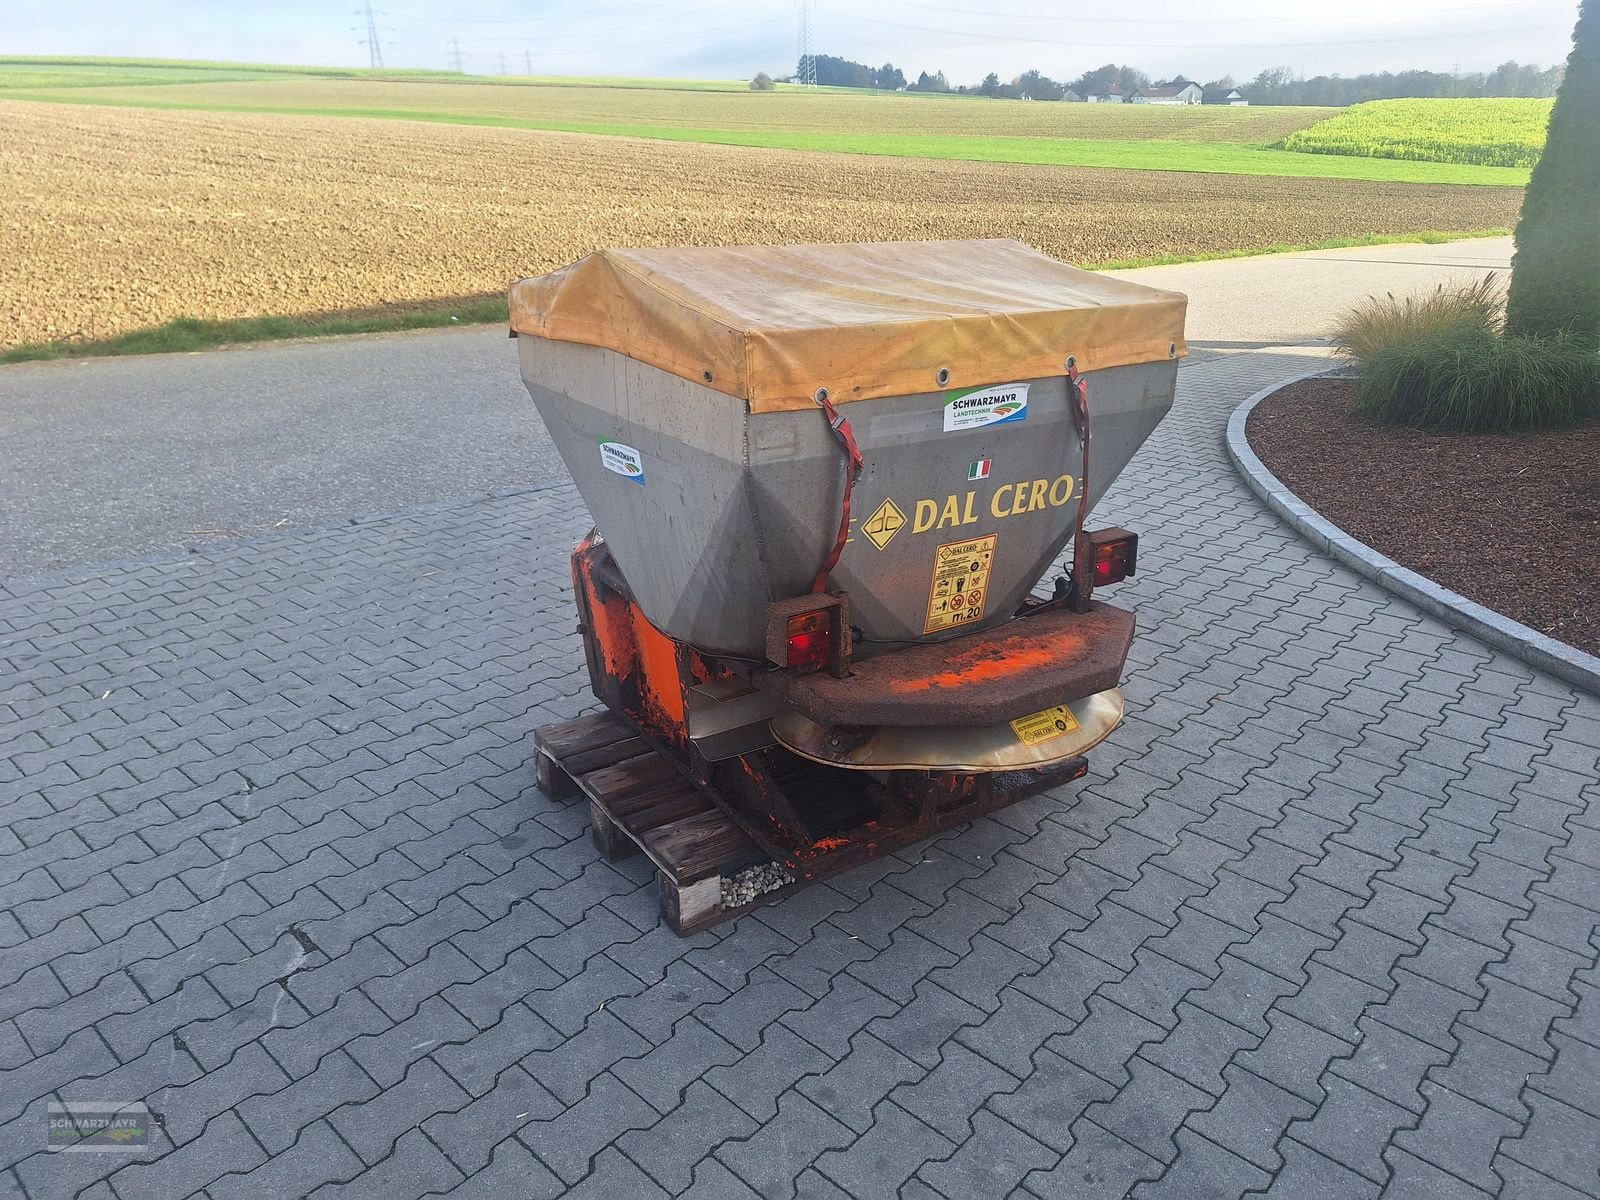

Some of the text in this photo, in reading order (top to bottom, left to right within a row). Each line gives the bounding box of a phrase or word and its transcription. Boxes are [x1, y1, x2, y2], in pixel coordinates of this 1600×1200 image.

[953, 393, 1016, 410] SCHWARZMAYR
[953, 407, 991, 418] LANDTECHNIK
[912, 491, 979, 535] DAL
[990, 474, 1075, 519] CERO
[952, 606, 981, 623] m.20
